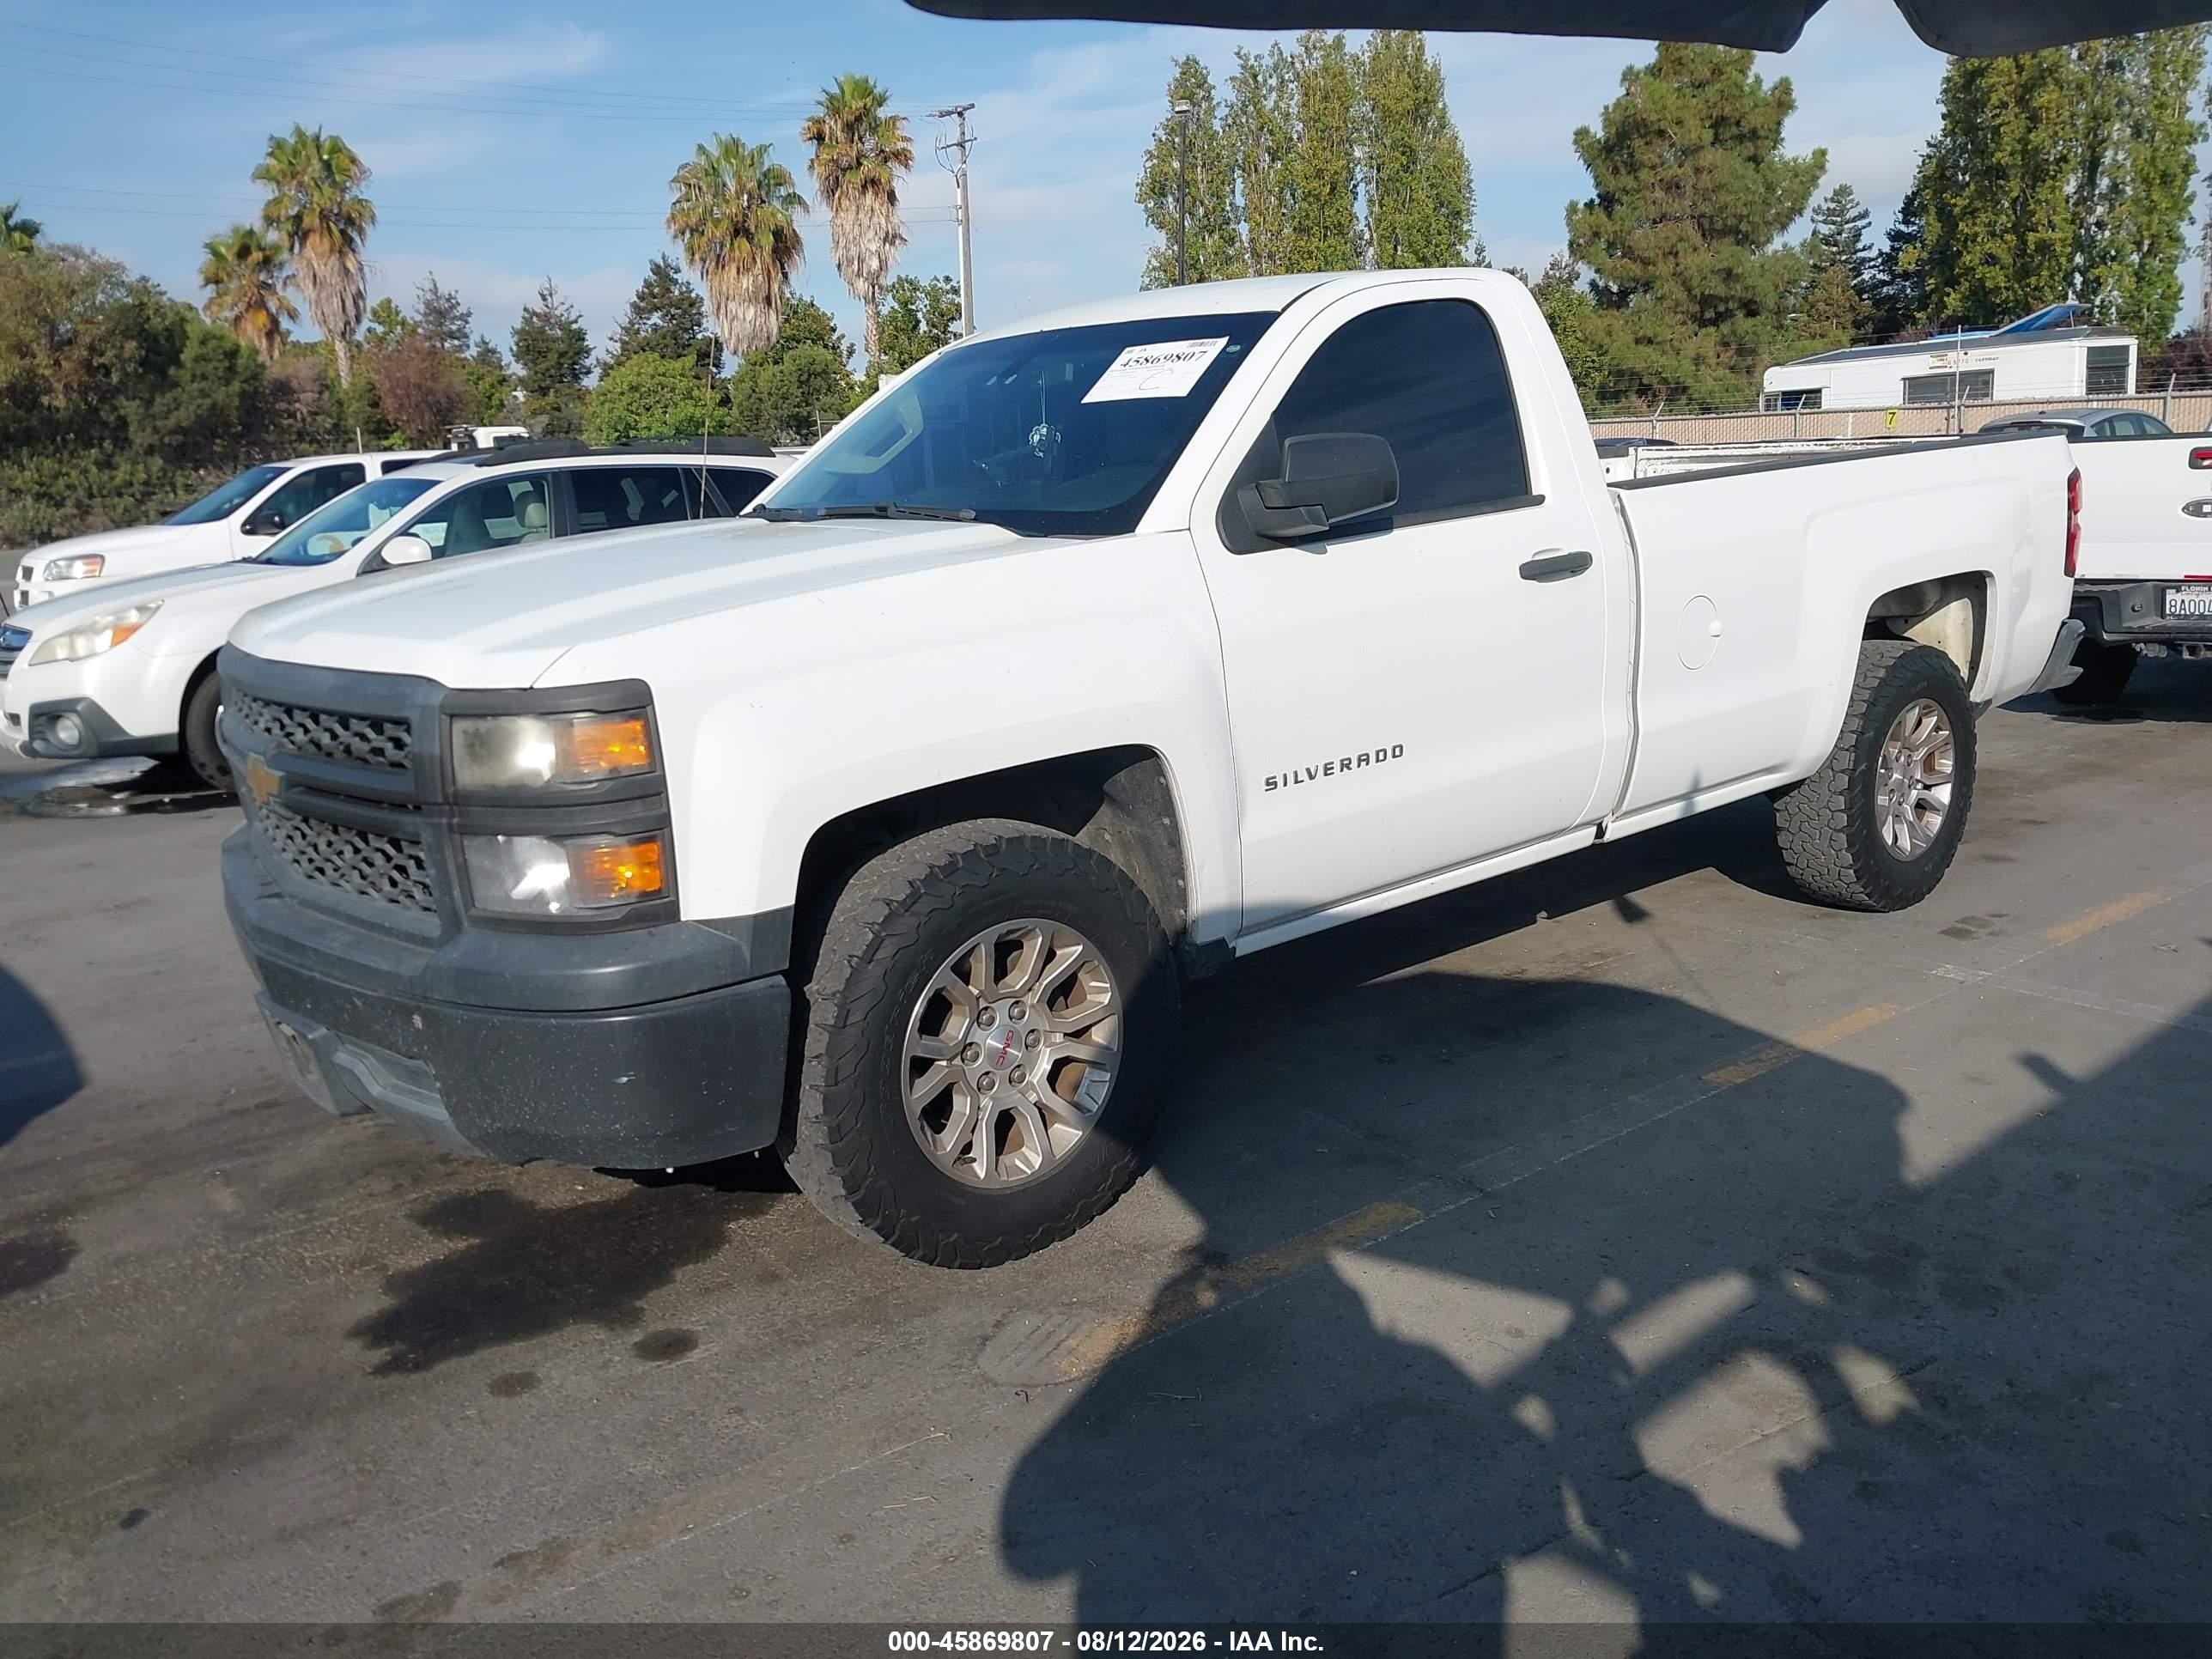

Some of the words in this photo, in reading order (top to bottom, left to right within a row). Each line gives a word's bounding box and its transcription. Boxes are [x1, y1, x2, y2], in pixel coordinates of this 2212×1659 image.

[1120, 350, 1209, 368] 45869807
[1888, 411, 1897, 425] 7
[1264, 743, 1404, 793] SILVERADO
[995, 1030, 1014, 1066] GMC
